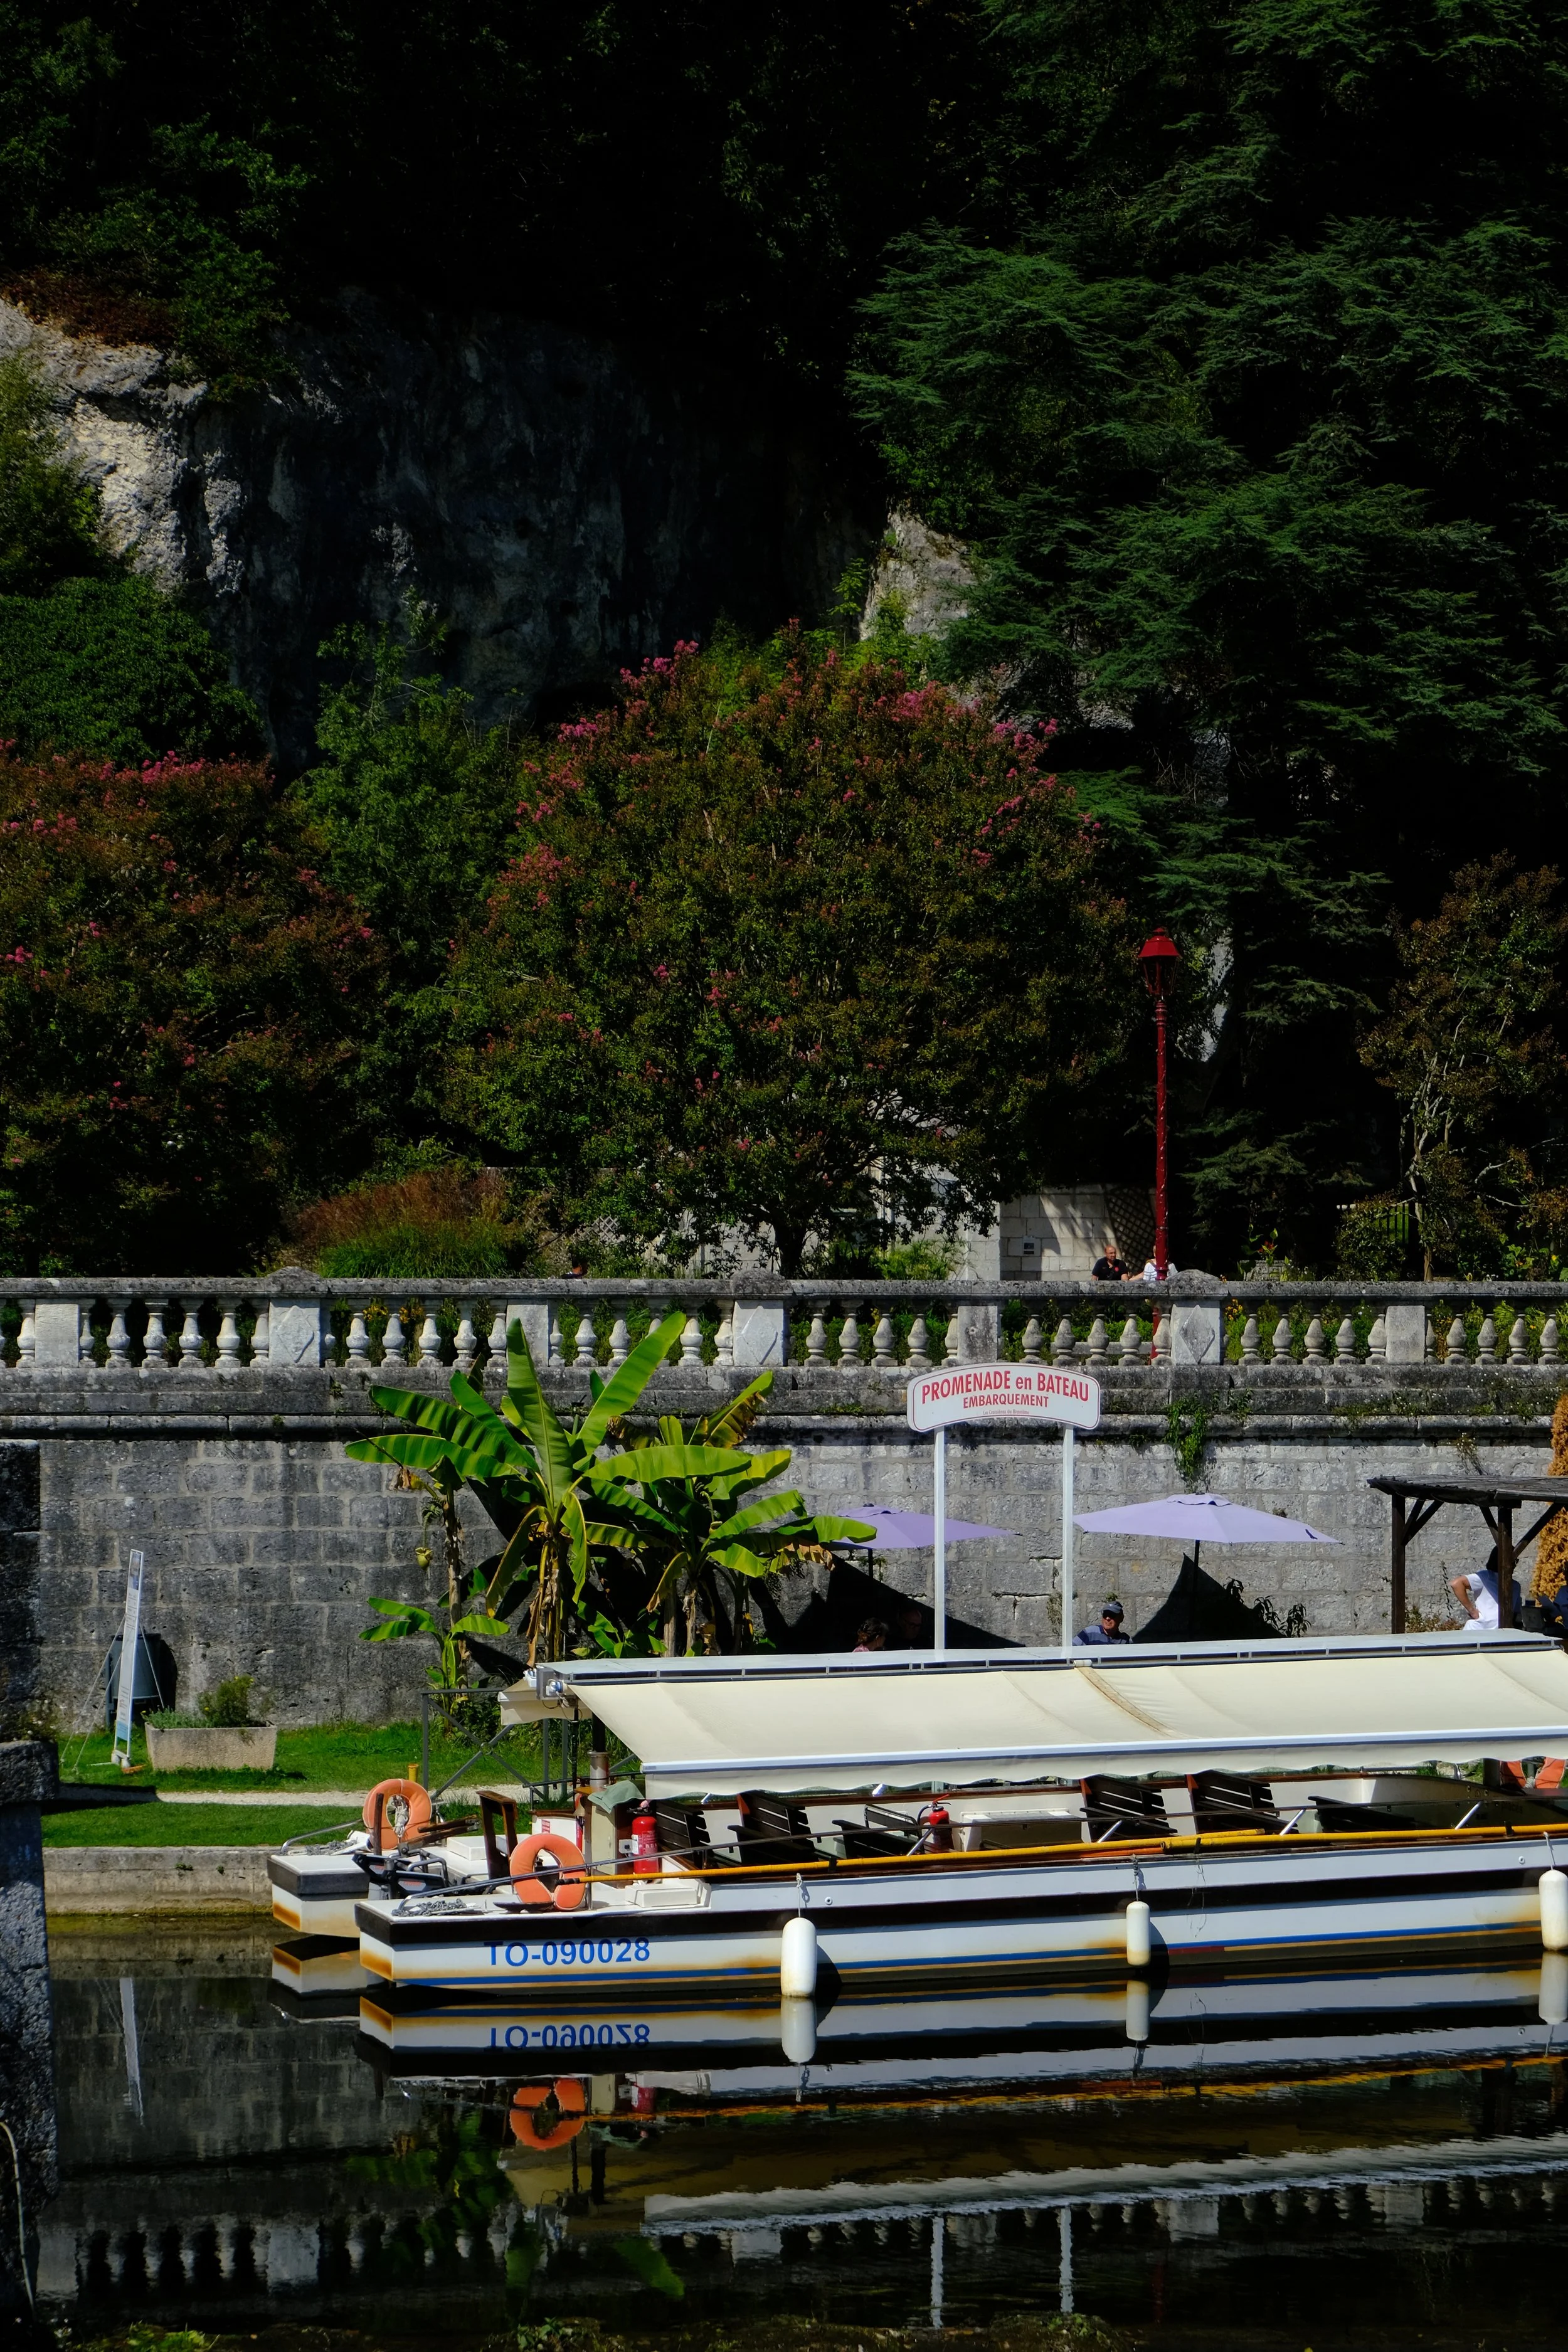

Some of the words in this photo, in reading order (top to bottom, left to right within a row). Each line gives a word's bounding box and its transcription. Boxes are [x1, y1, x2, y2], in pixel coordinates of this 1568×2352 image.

[923, 1370, 1010, 1404] PROMENADE
[1015, 1375, 1032, 1390] en
[1037, 1372, 1089, 1402] BATEAU
[963, 1394, 1049, 1409] EMBARQUEMENT
[484, 1937, 650, 1966] TO-090028
